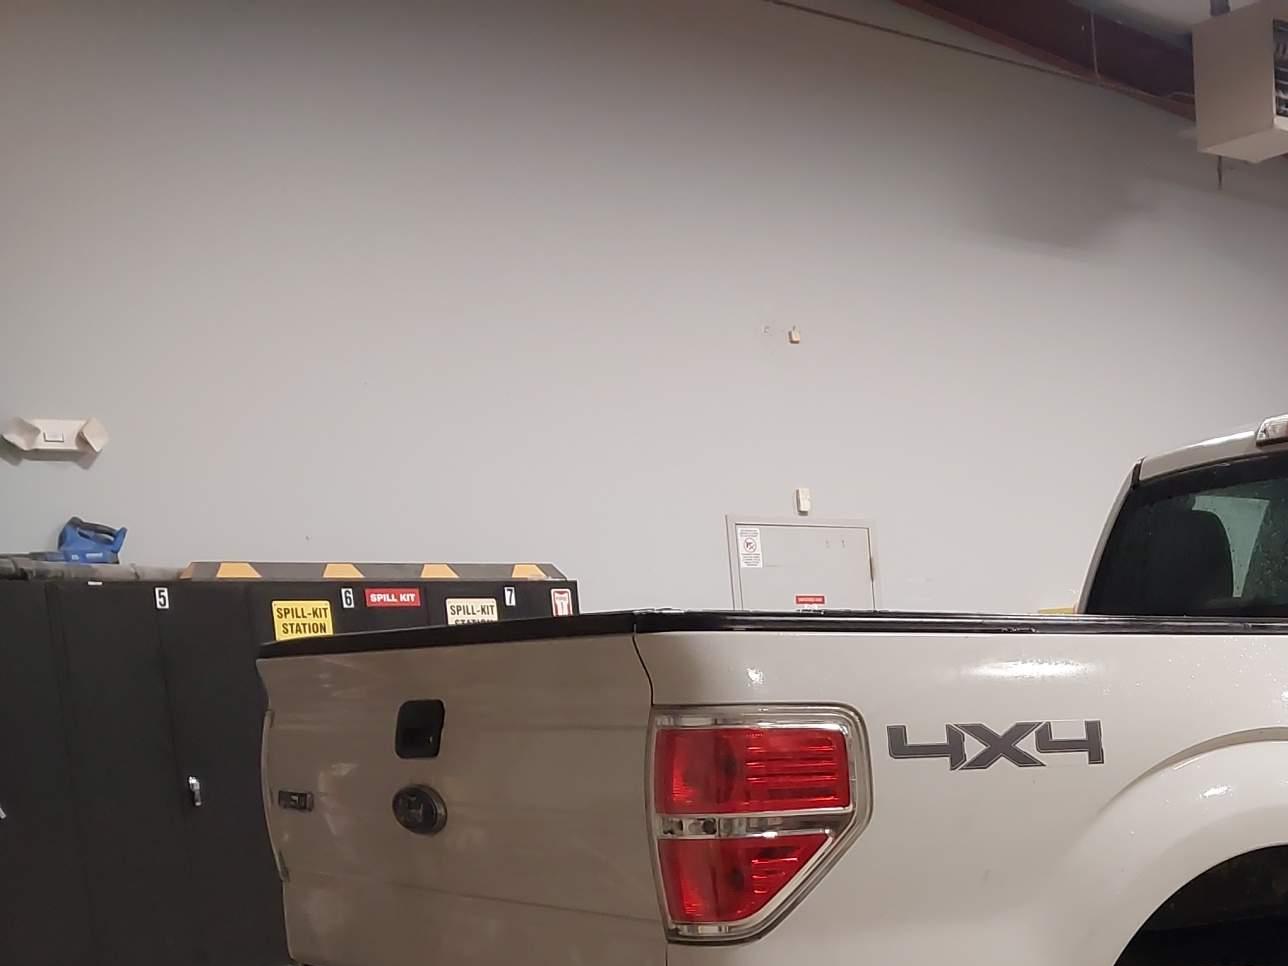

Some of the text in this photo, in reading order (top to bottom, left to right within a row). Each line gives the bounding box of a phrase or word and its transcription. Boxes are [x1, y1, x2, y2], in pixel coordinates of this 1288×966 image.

[158, 589, 167, 607] 5
[343, 590, 353, 607] 6
[369, 592, 416, 602] SPILL KIT
[507, 589, 514, 604] 7
[276, 607, 328, 619] SPILL-KIT
[450, 604, 495, 616] SPILL-KIT
[282, 622, 327, 634] STATION
[886, 720, 1104, 771] 4X4
